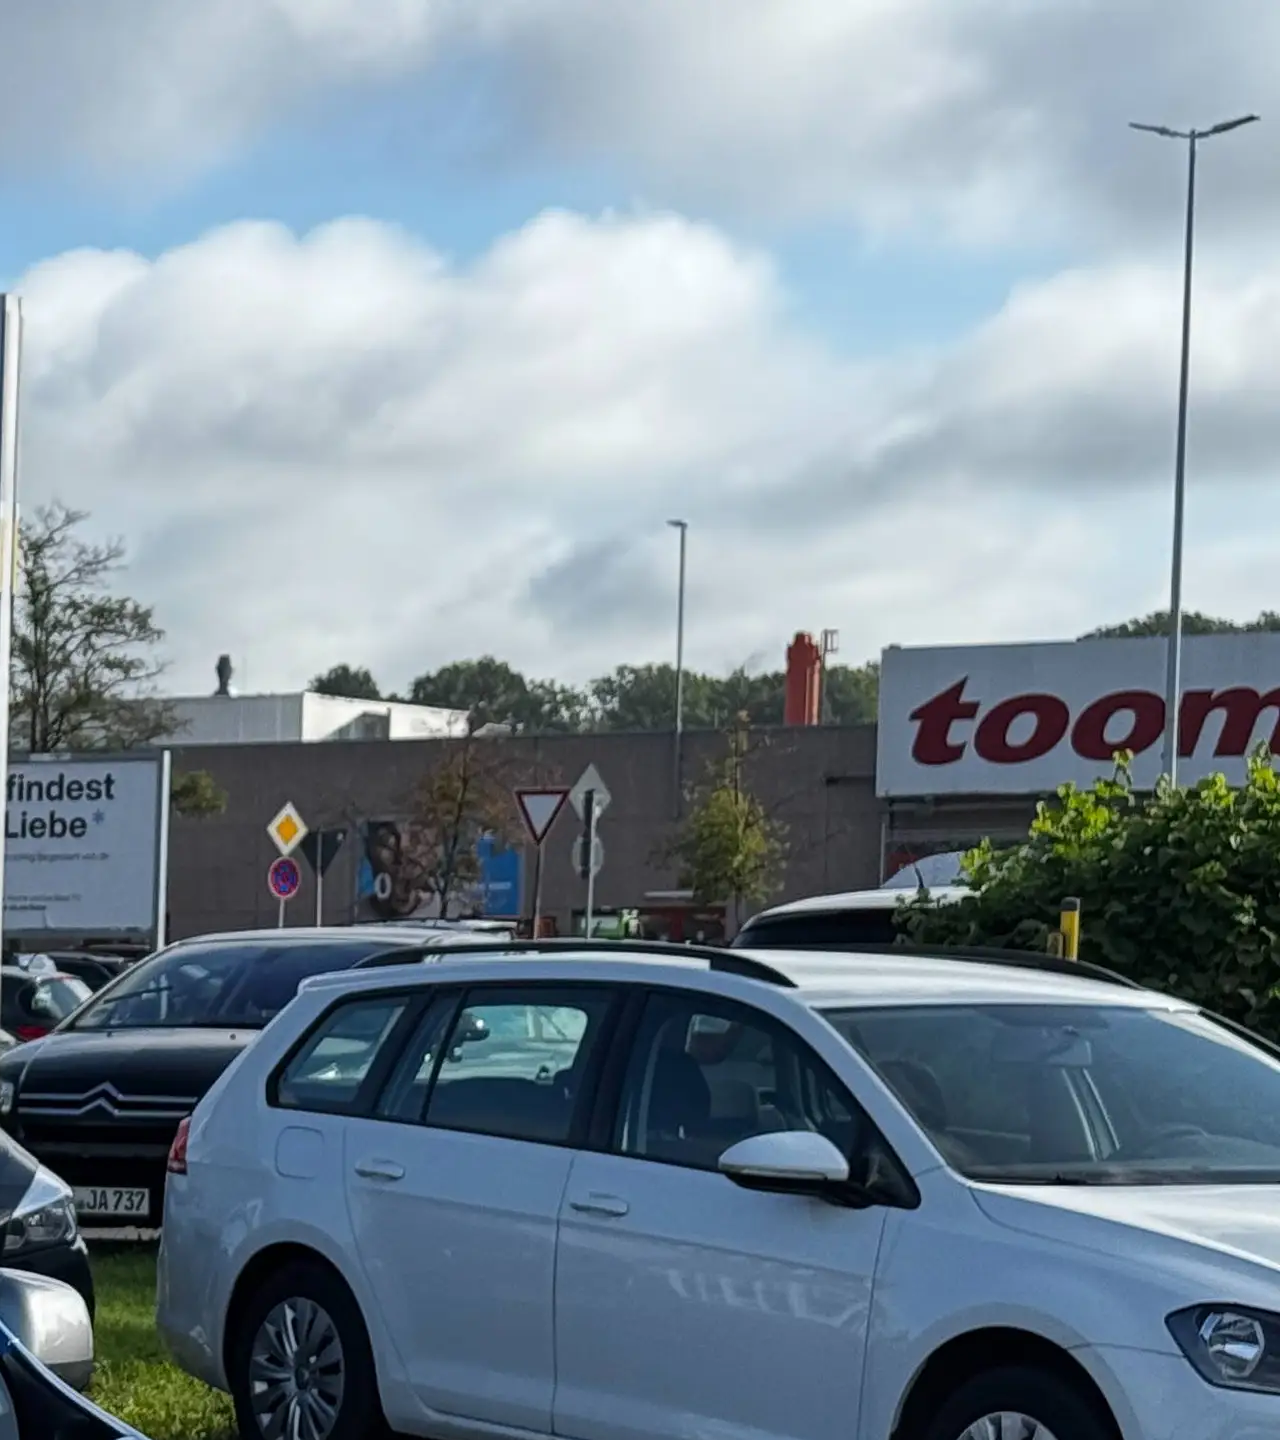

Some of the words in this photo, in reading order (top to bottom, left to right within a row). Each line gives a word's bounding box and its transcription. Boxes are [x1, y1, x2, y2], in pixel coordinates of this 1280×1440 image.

[908, 674, 1280, 765] toom
[6, 772, 116, 802] findest
[113, 1189, 146, 1212] 737
